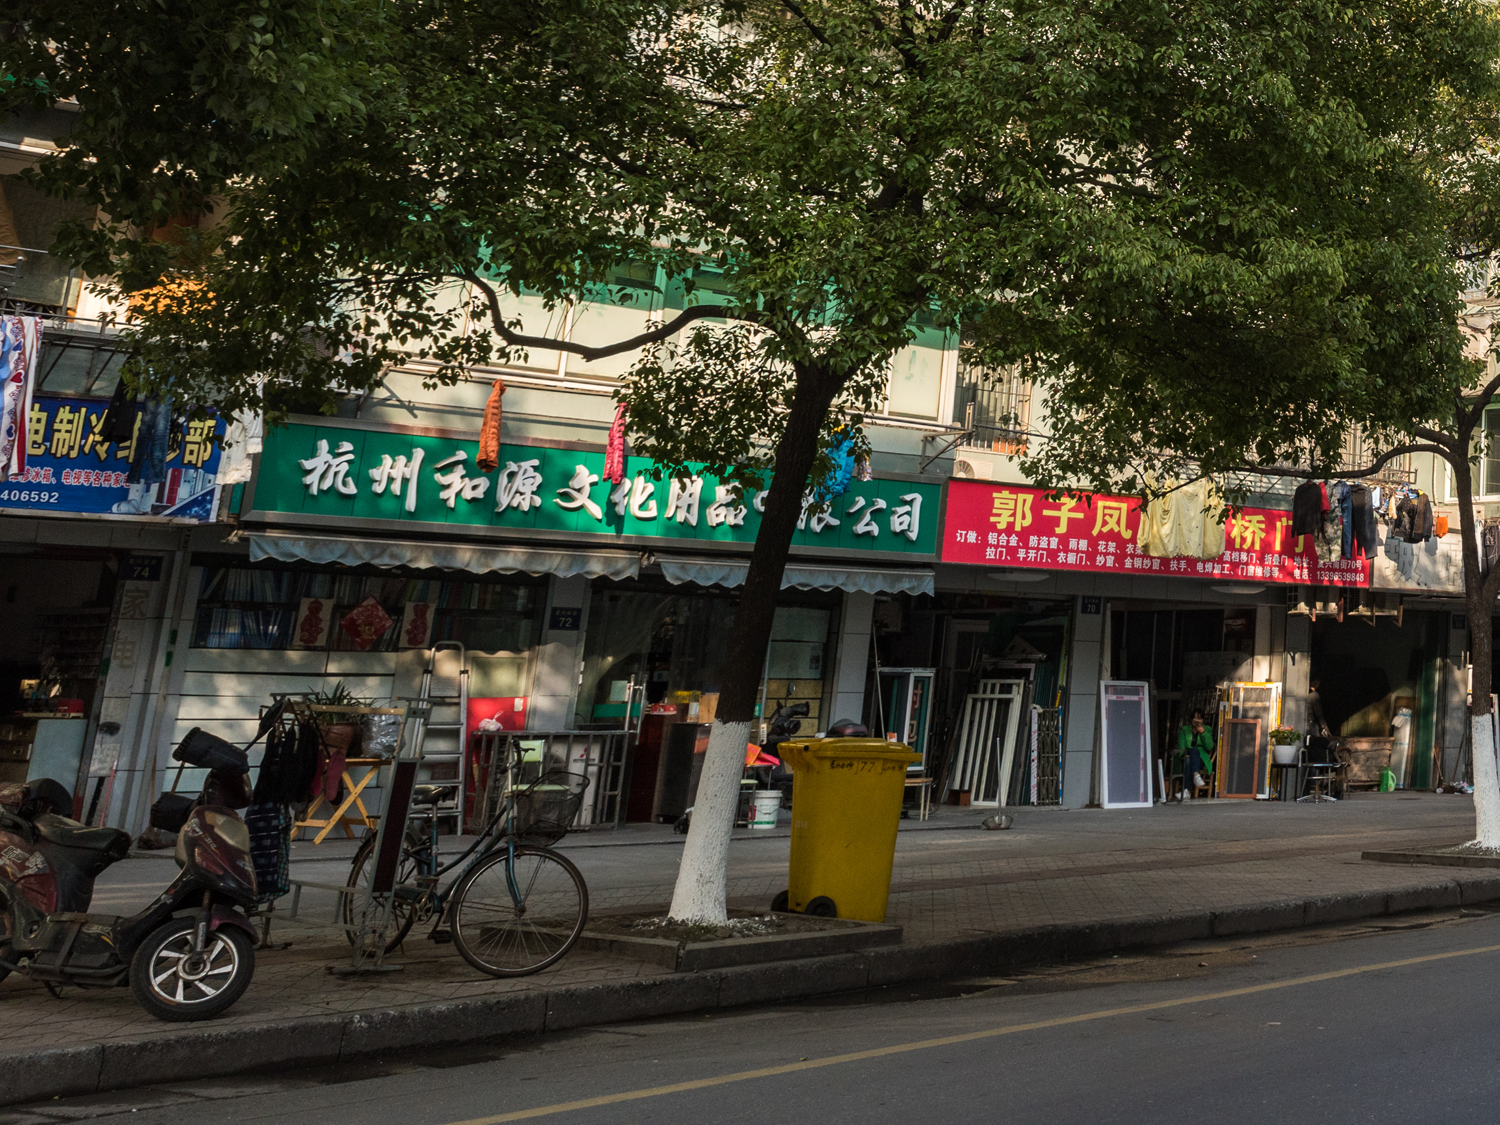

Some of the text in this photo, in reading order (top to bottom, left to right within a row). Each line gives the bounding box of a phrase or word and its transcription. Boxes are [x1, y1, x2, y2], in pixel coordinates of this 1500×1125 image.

[28, 403, 217, 468] 电制冷部
[0, 489, 59, 503] 406592
[300, 438, 923, 542] 杭州和源文化用品限公司
[989, 489, 1133, 540] 郭子凤
[132, 566, 150, 578] 74
[1087, 604, 1096, 613] 70
[559, 617, 573, 627] 72
